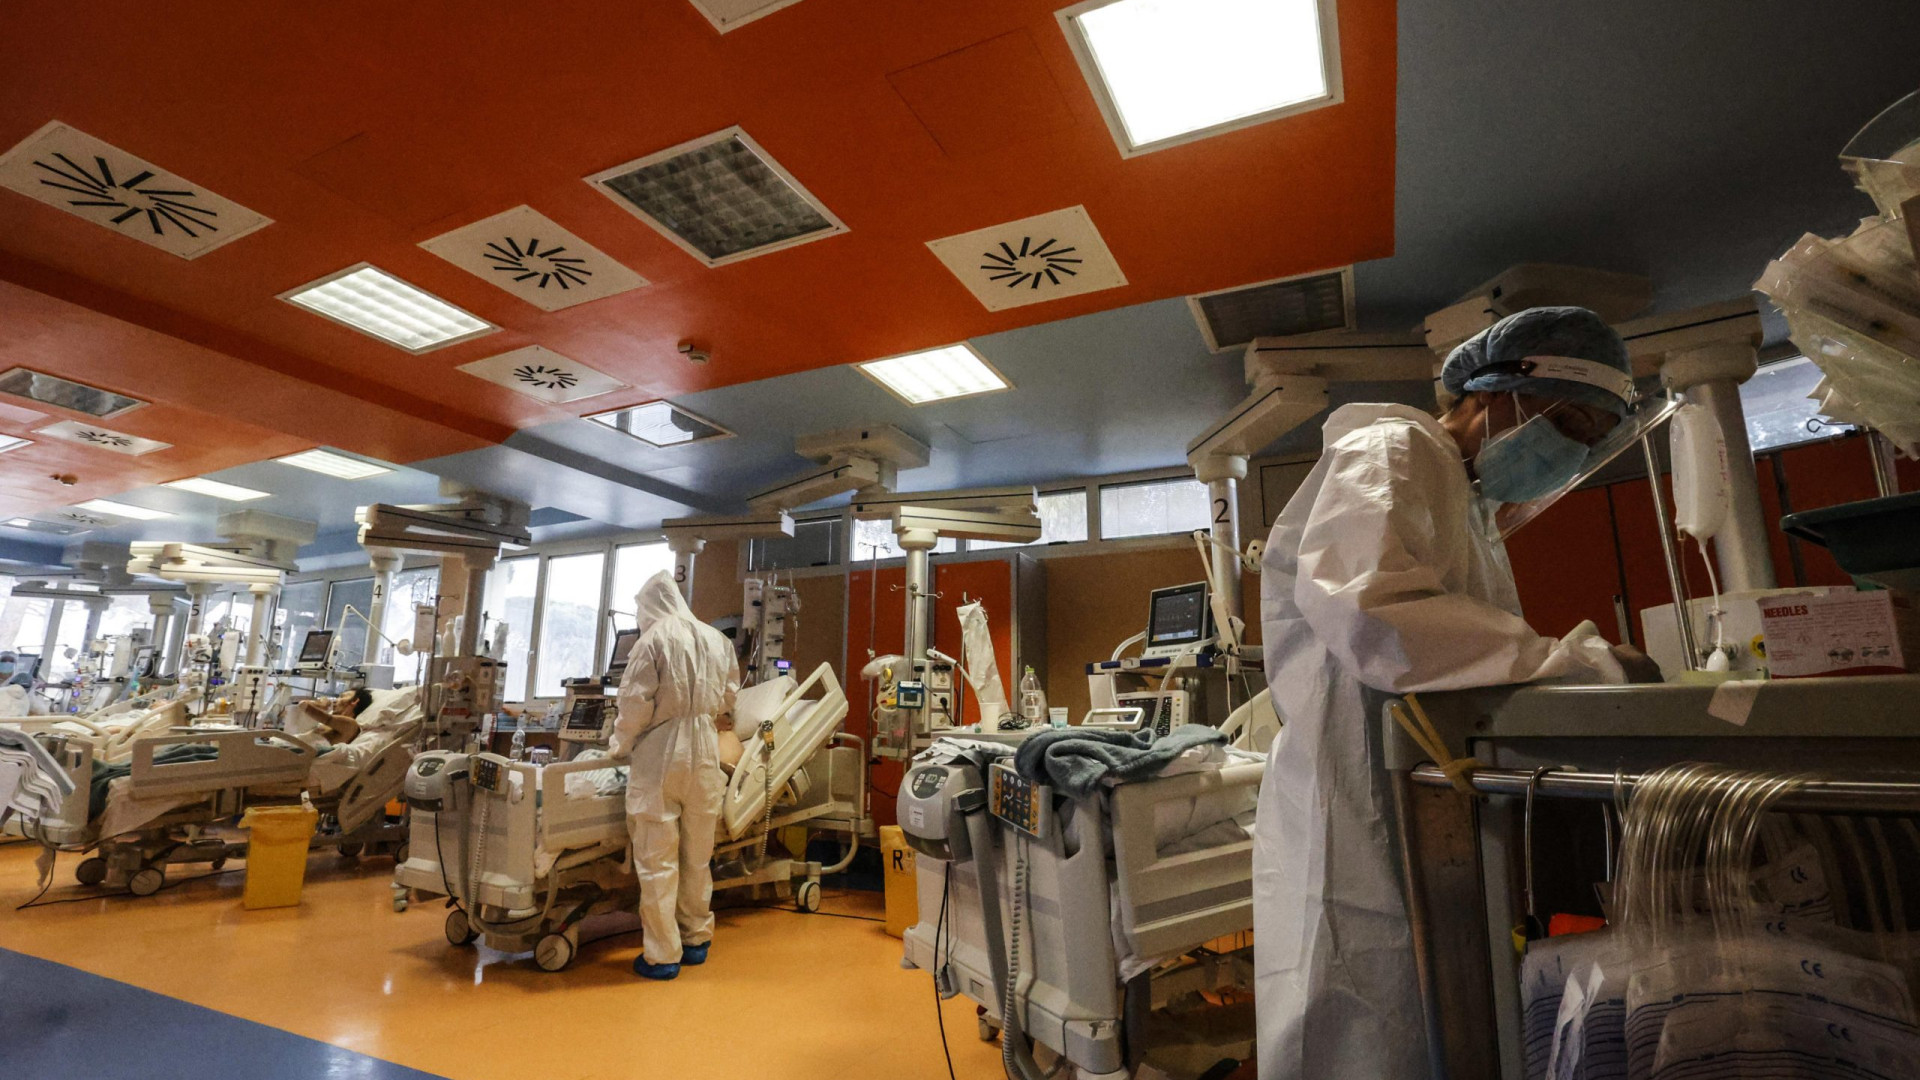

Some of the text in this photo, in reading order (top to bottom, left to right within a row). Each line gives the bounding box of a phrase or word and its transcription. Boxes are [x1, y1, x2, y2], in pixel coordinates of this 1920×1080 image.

[1214, 497, 1231, 524] 2
[675, 564, 686, 583] 3
[373, 584, 383, 599] 4
[191, 603, 200, 617] 5
[1763, 605, 1809, 618] NEEDLES
[892, 849, 904, 871] R
[1800, 959, 1825, 979] CE
[1827, 1022, 1854, 1043] CE
